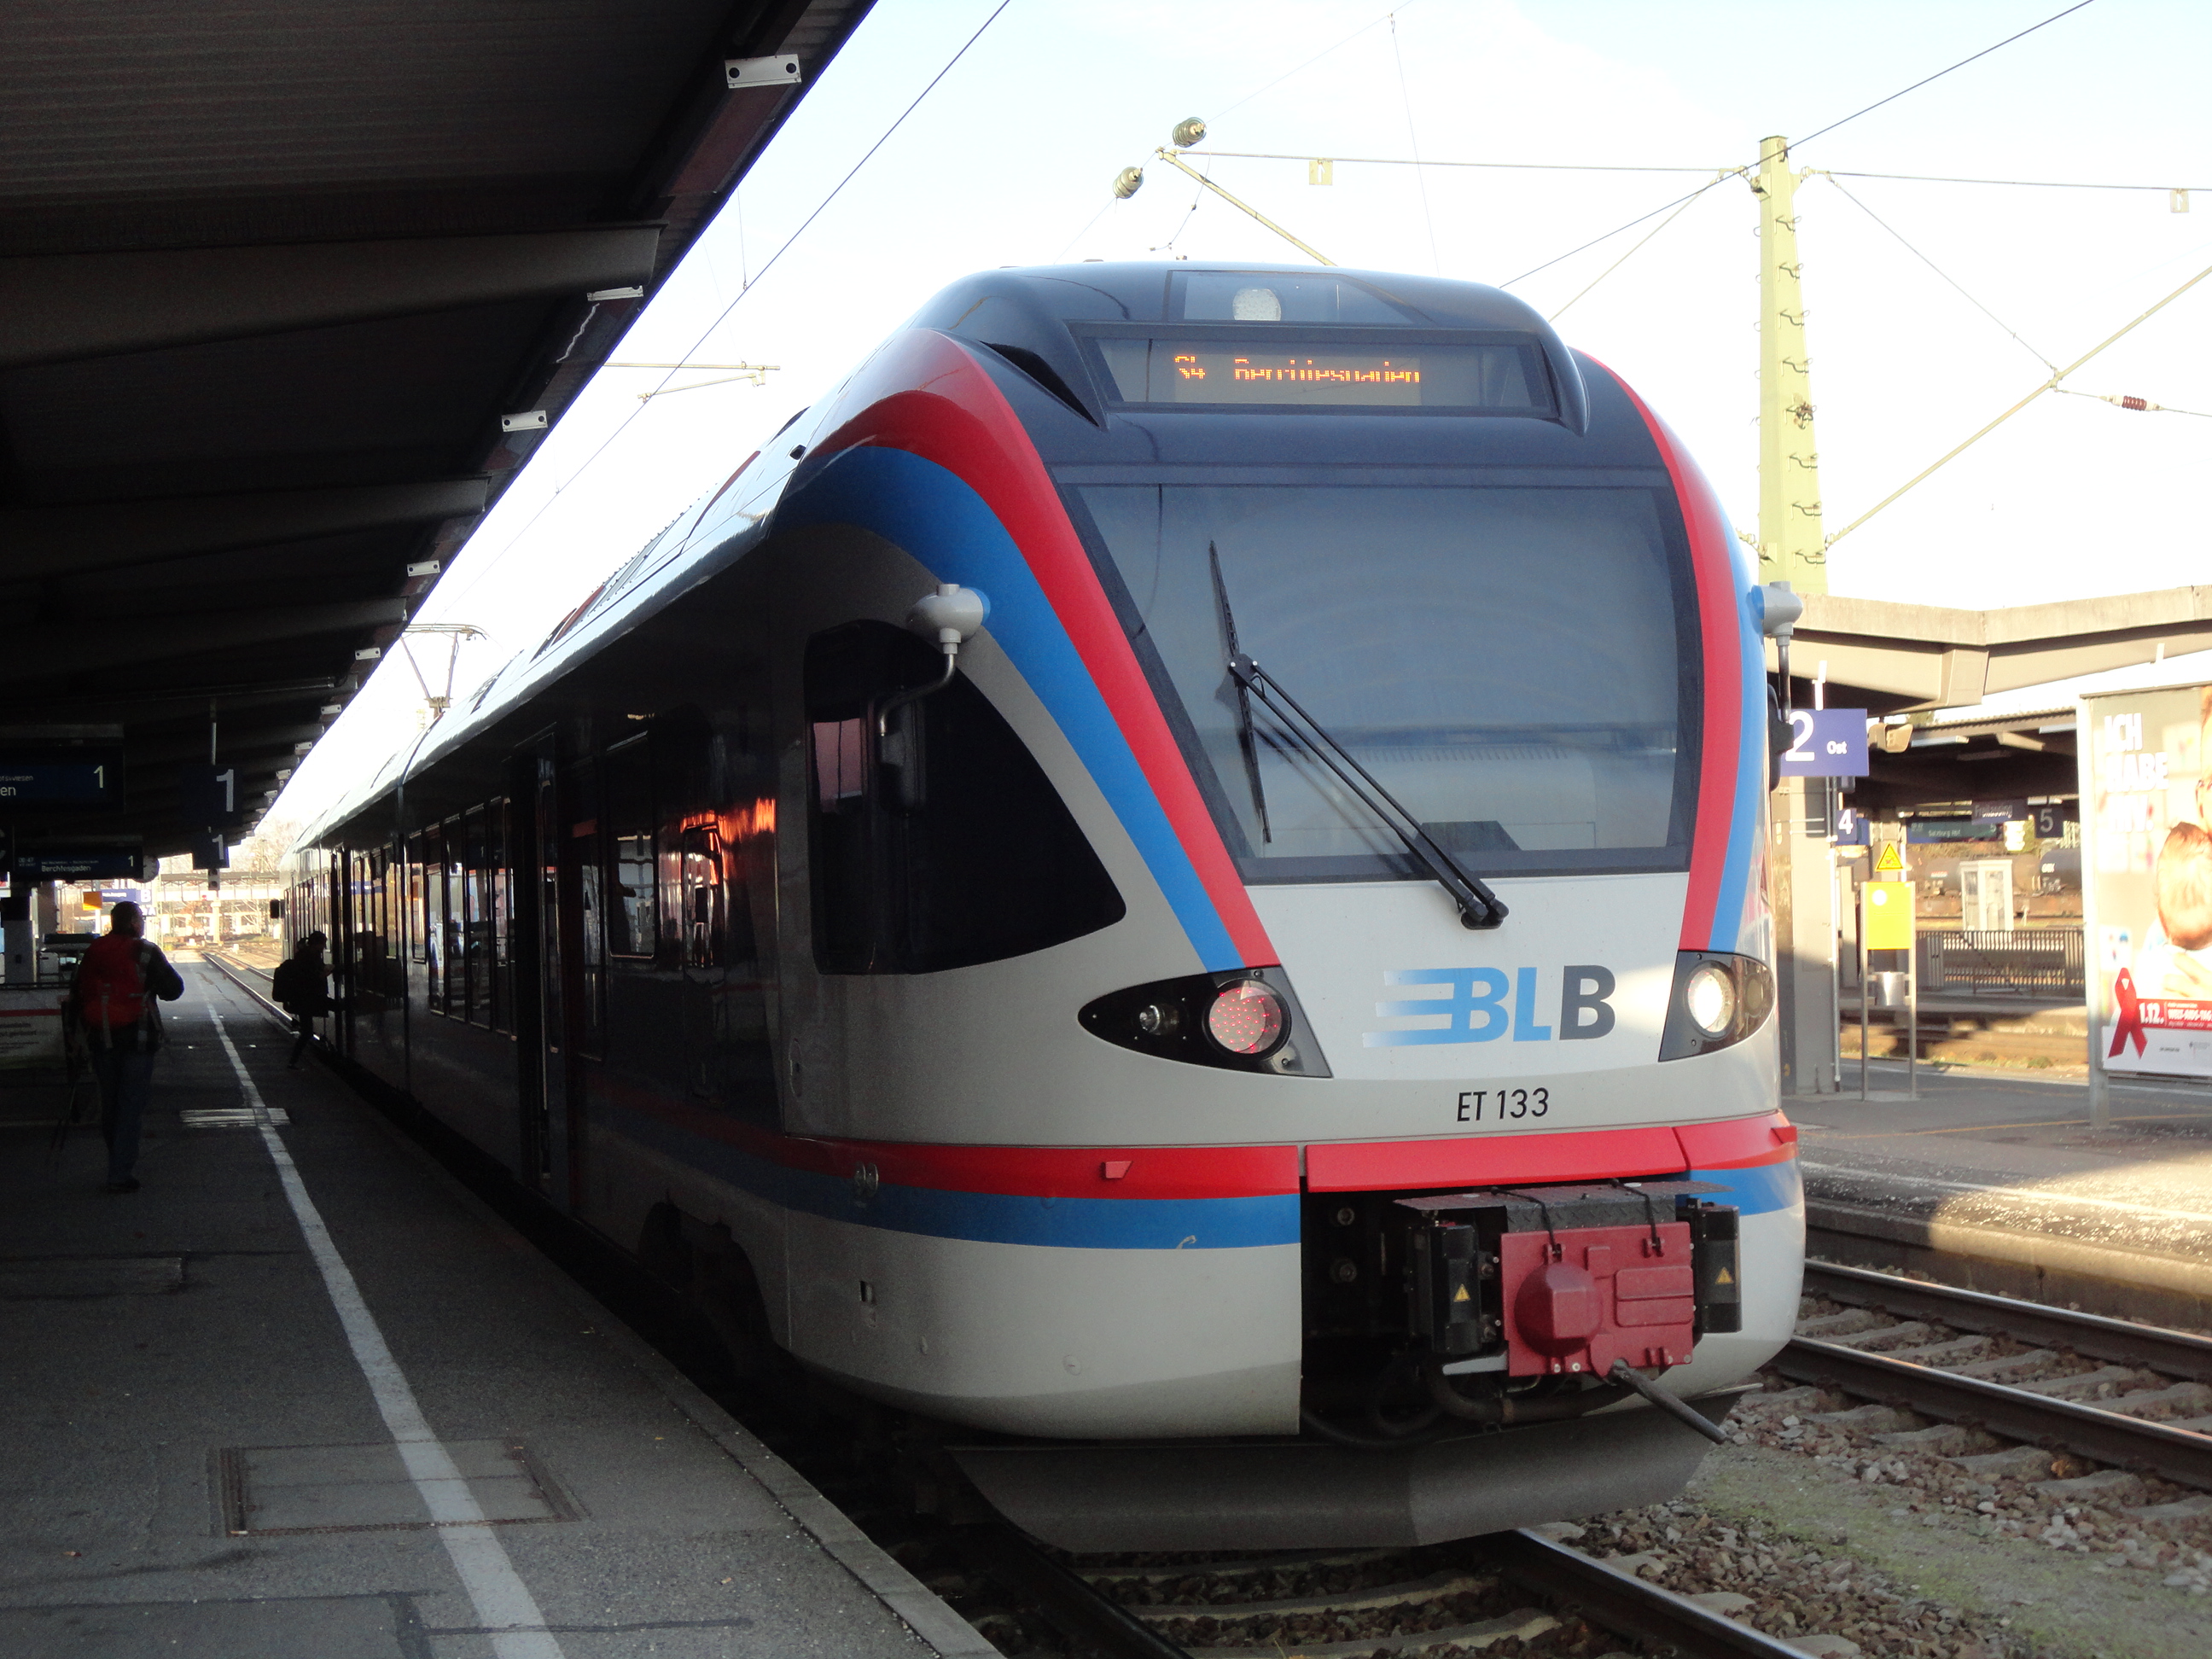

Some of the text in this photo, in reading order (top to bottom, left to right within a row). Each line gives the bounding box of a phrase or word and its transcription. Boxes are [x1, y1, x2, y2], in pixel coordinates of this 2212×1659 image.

[1785, 710, 1848, 762] 2 Ost
[2104, 713, 2143, 752] ICH
[93, 765, 104, 789] 1
[216, 768, 235, 812] 1
[2105, 752, 2169, 793] HABE
[1838, 809, 1854, 835] 4
[2039, 807, 2054, 833] 5
[2108, 794, 2155, 833] HIV.
[127, 855, 134, 867] 1
[212, 834, 224, 860] 1
[1363, 964, 1616, 1048] BLB
[1457, 1086, 1550, 1122] ET 133
